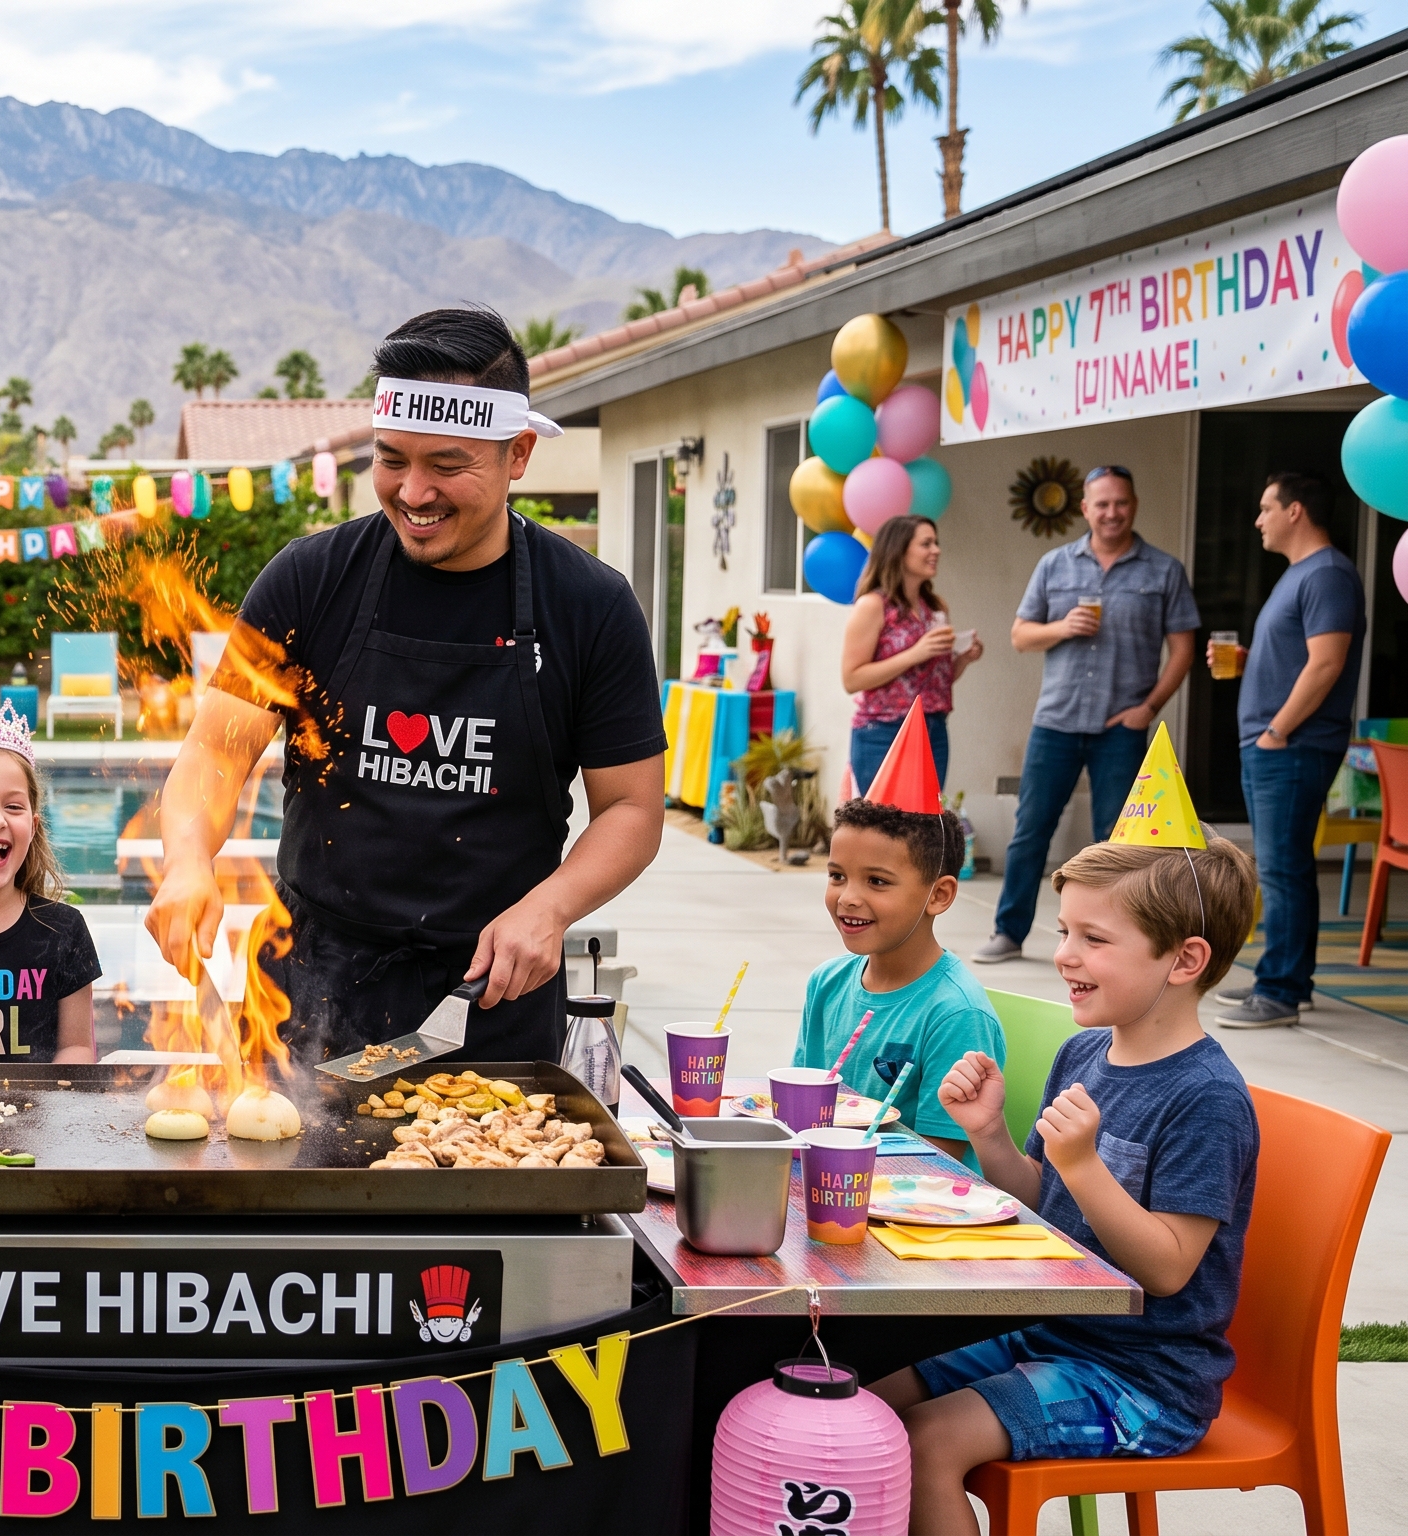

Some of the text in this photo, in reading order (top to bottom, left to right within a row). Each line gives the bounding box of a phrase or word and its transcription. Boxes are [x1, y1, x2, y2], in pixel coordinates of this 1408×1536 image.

[997, 229, 1323, 365] HAPPY 7TH BIRTHDAY
[407, 393, 494, 428] HIBACHI
[687, 1054, 725, 1069] HAPPY
[86, 1271, 393, 1335] HIBACHI
